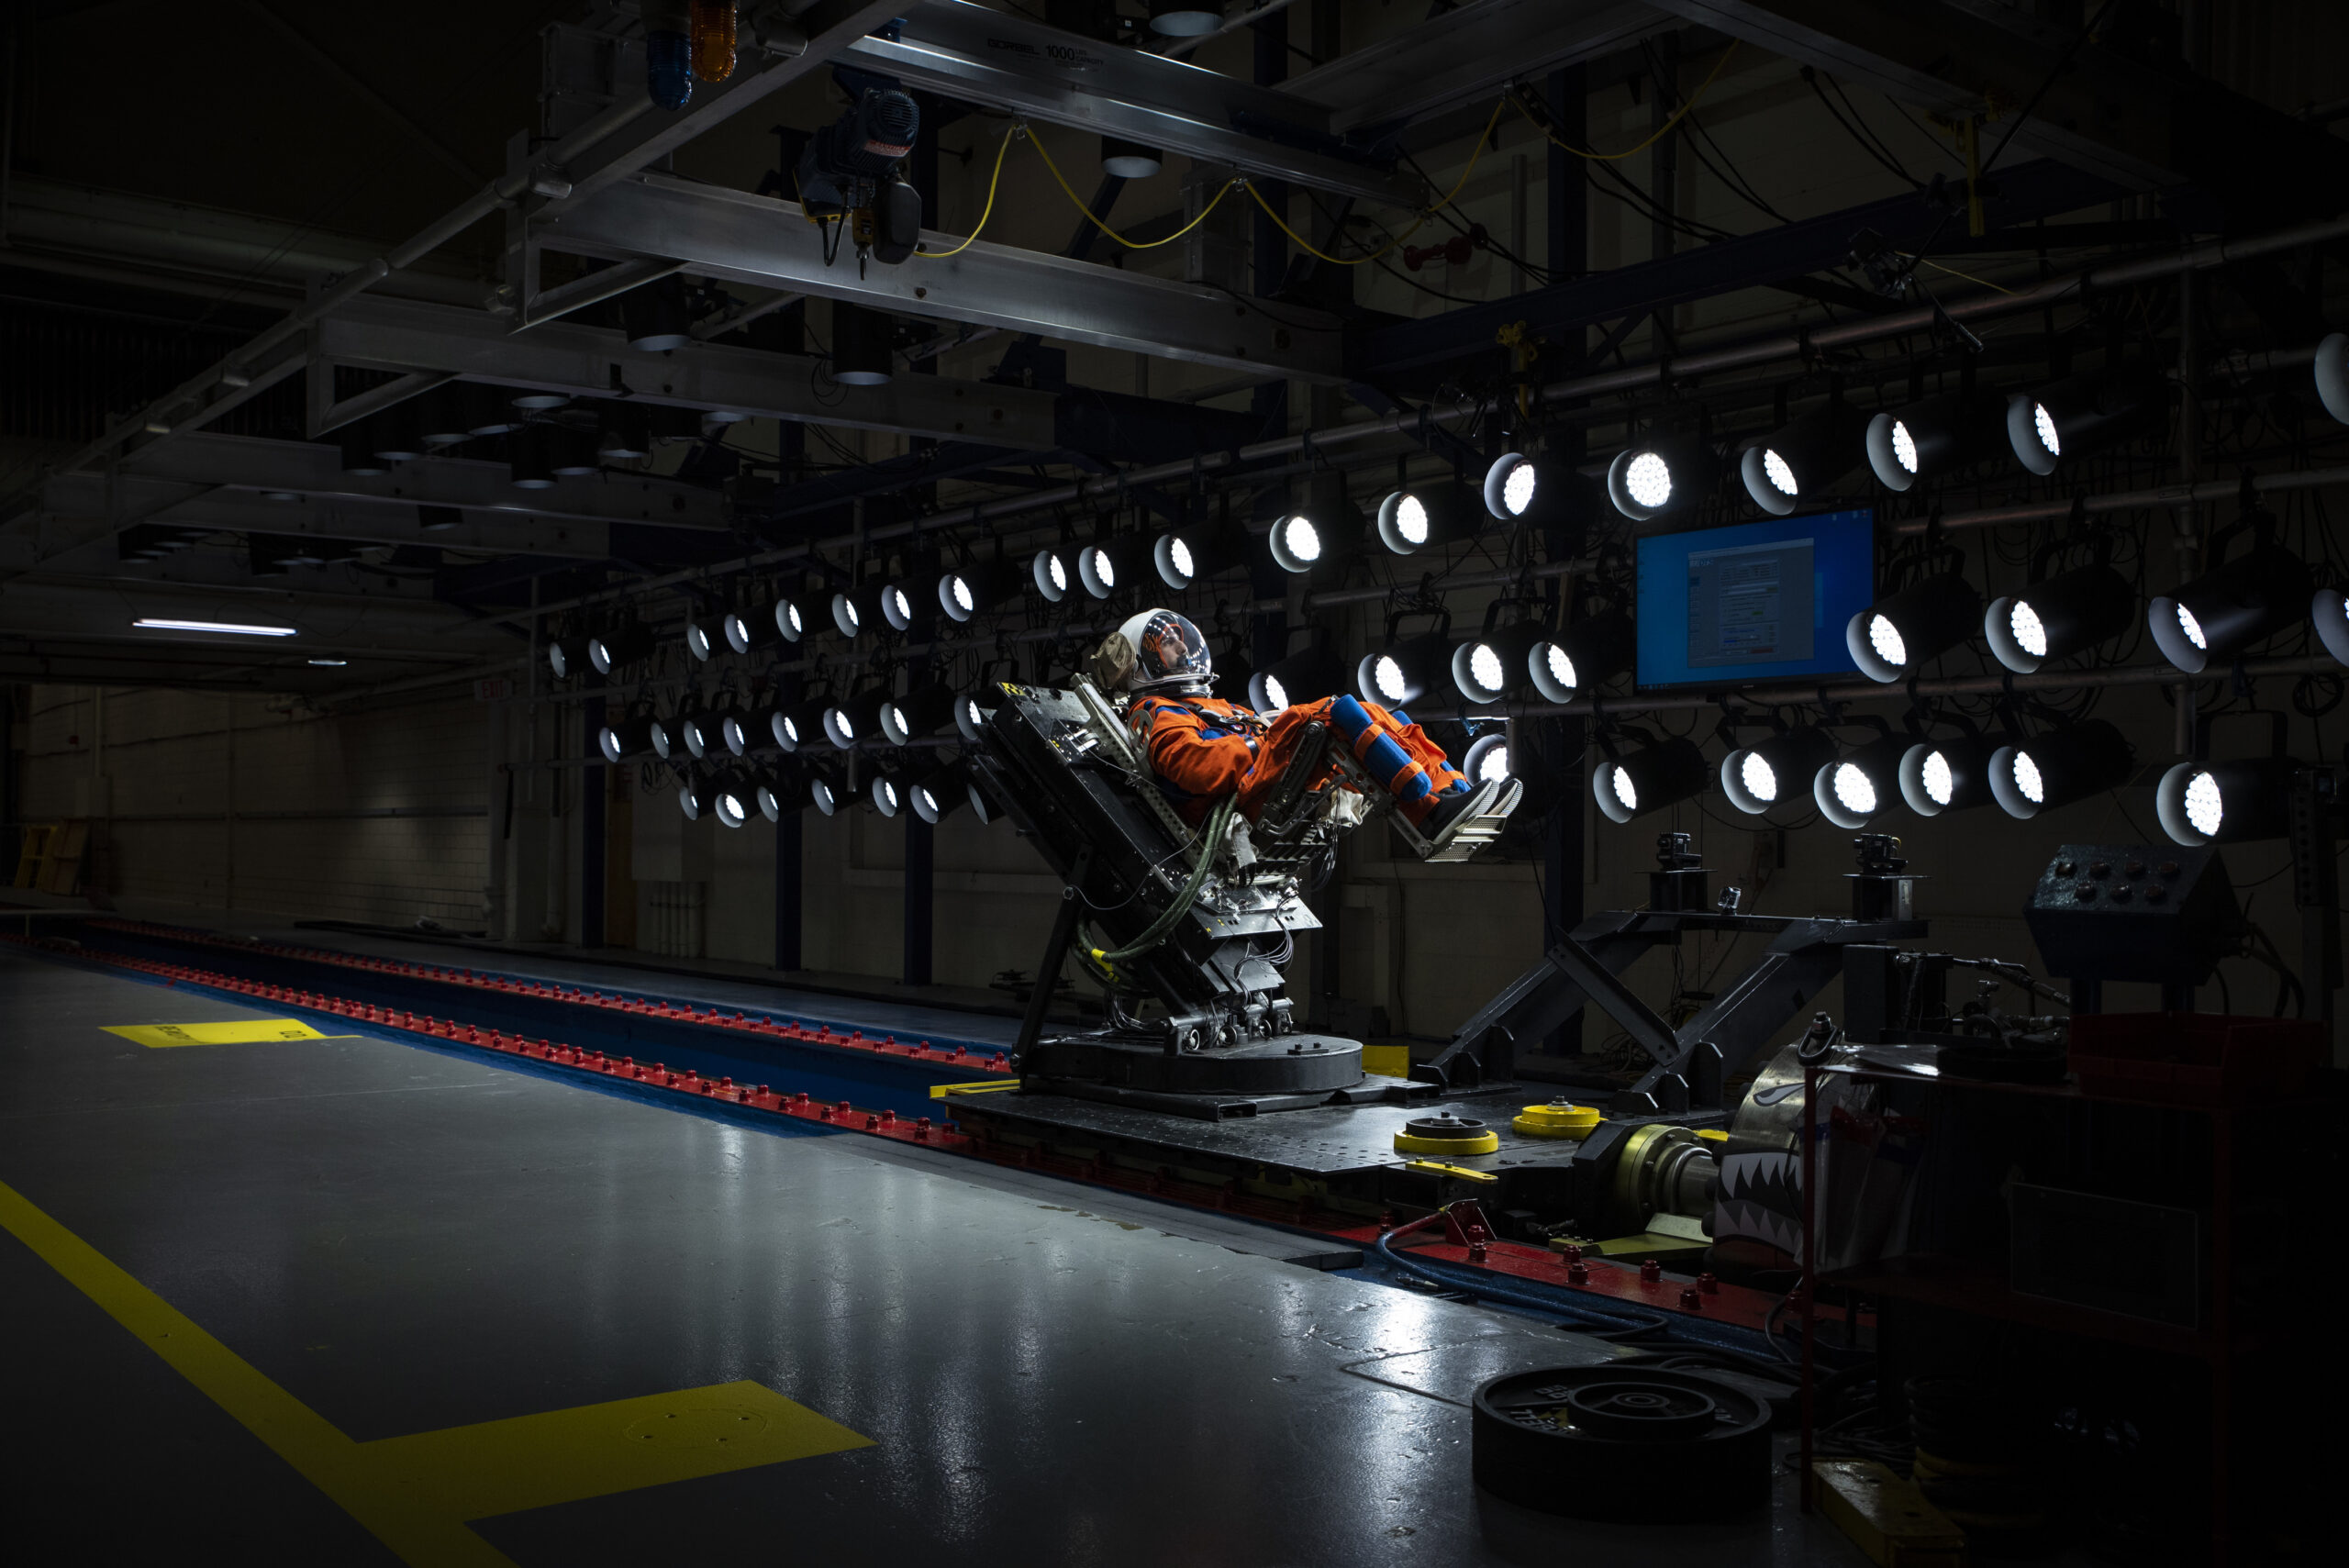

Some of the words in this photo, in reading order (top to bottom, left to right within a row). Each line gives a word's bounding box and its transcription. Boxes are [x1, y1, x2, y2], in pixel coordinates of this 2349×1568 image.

[987, 38, 1040, 55] GORBEL
[1045, 44, 1075, 61] 1000
[482, 680, 505, 698] EXIT
